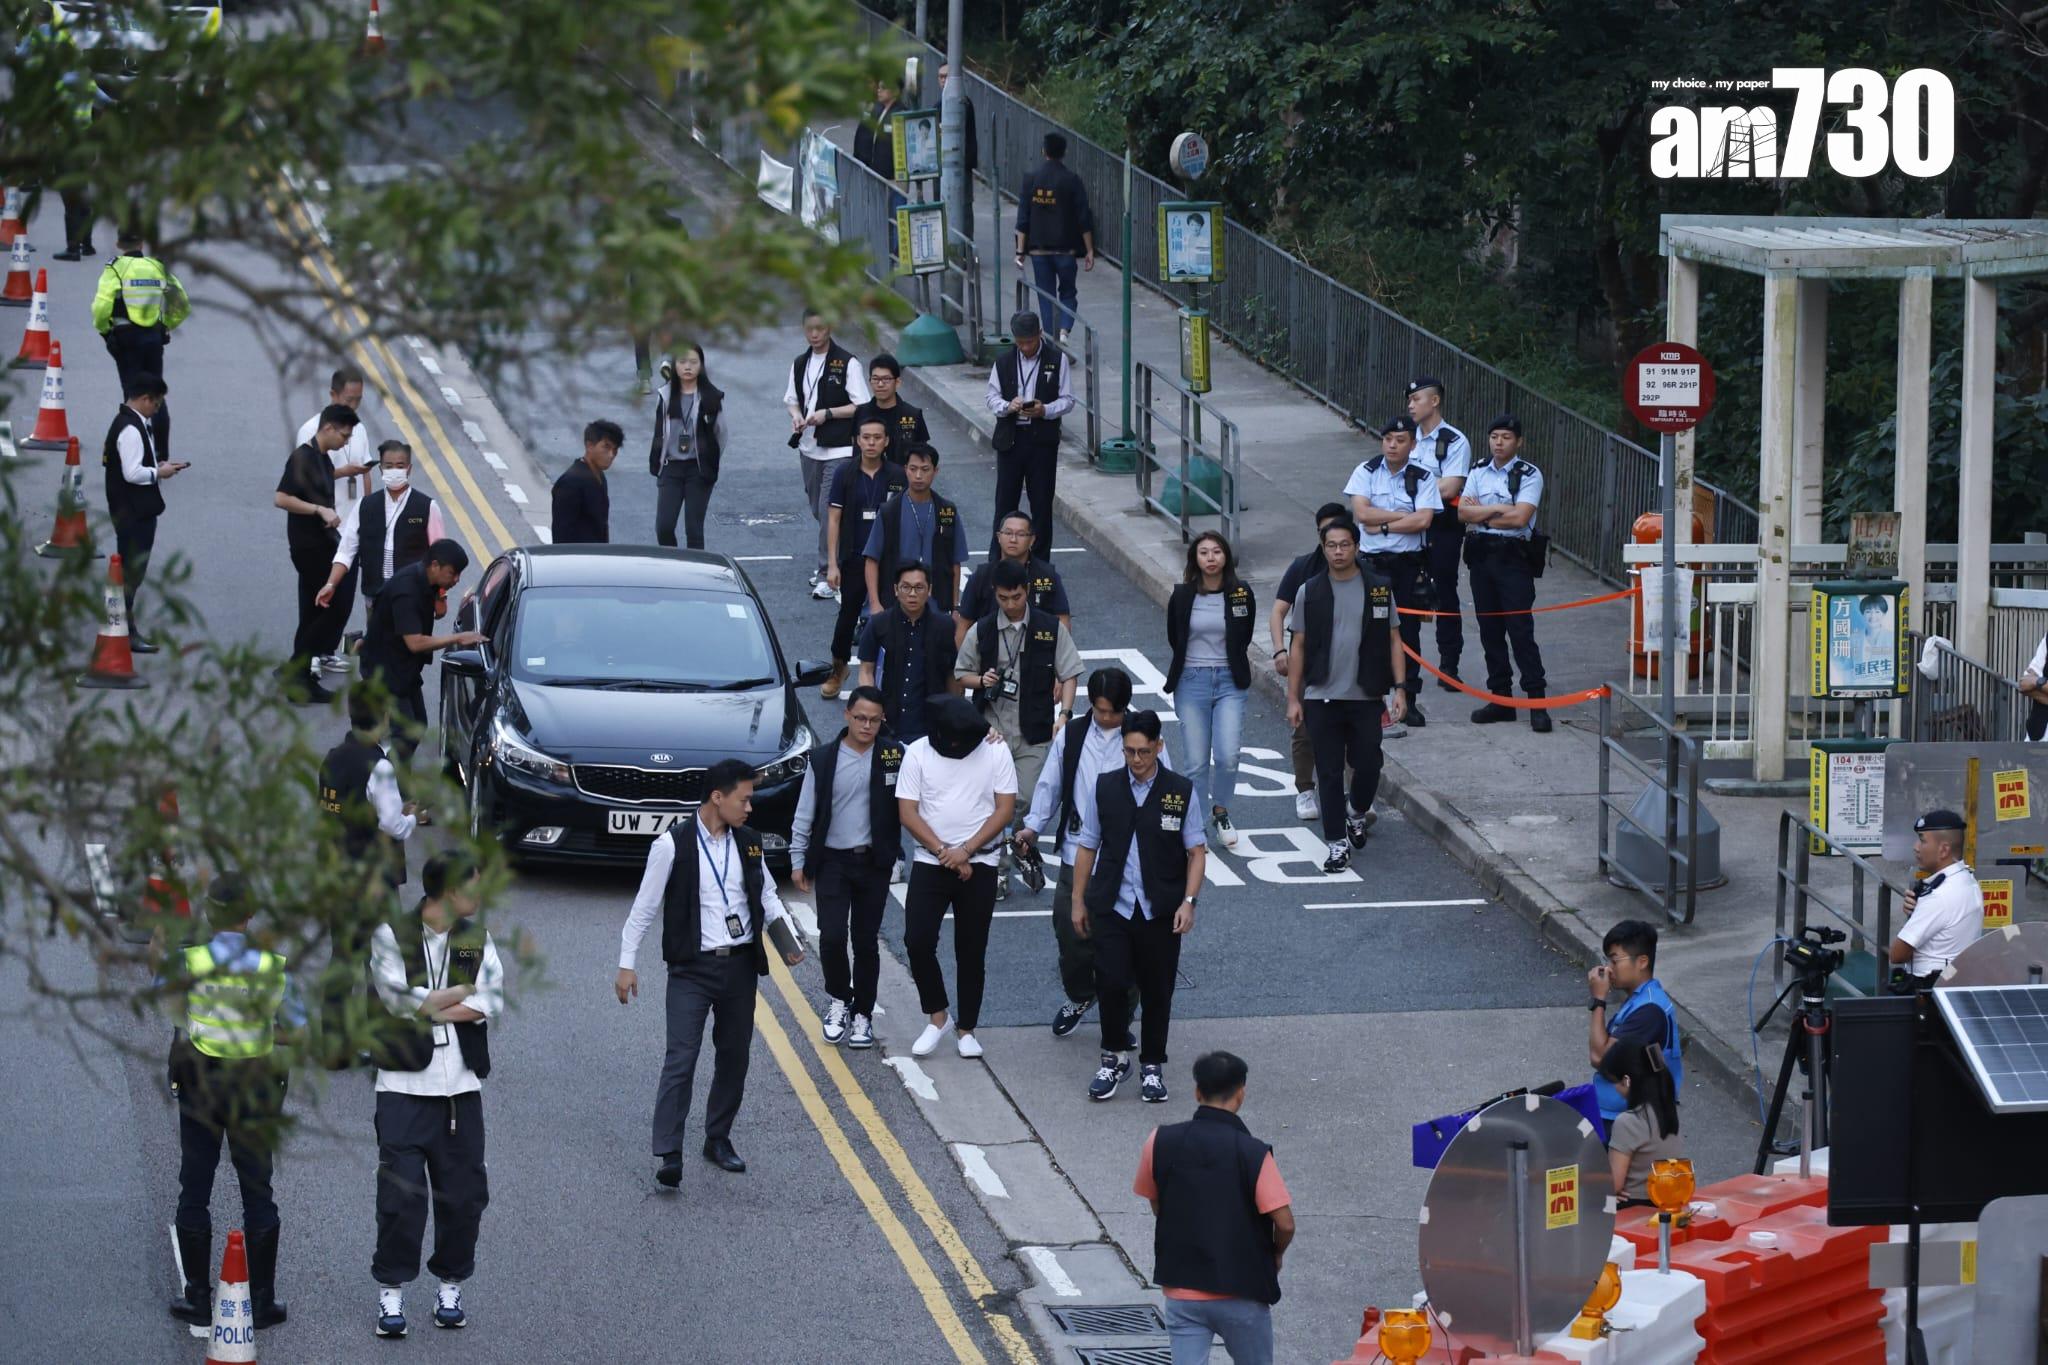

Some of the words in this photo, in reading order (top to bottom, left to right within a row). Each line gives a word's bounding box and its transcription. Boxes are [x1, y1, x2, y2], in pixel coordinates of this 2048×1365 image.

[1032, 196, 1056, 205] POLICE
[1661, 352, 1681, 361] KMB
[1646, 368, 1656, 376] 91
[1661, 368, 1678, 376] 91M
[1680, 368, 1696, 376] 91P
[1646, 381, 1656, 389] 92
[1679, 381, 1698, 389] 291P
[1832, 598, 1851, 658] 方國珊
[1836, 756, 1852, 764] 104
[1164, 803, 1183, 812] OCTB
[612, 813, 641, 831] UW
[219, 1298, 253, 1318] 警察
